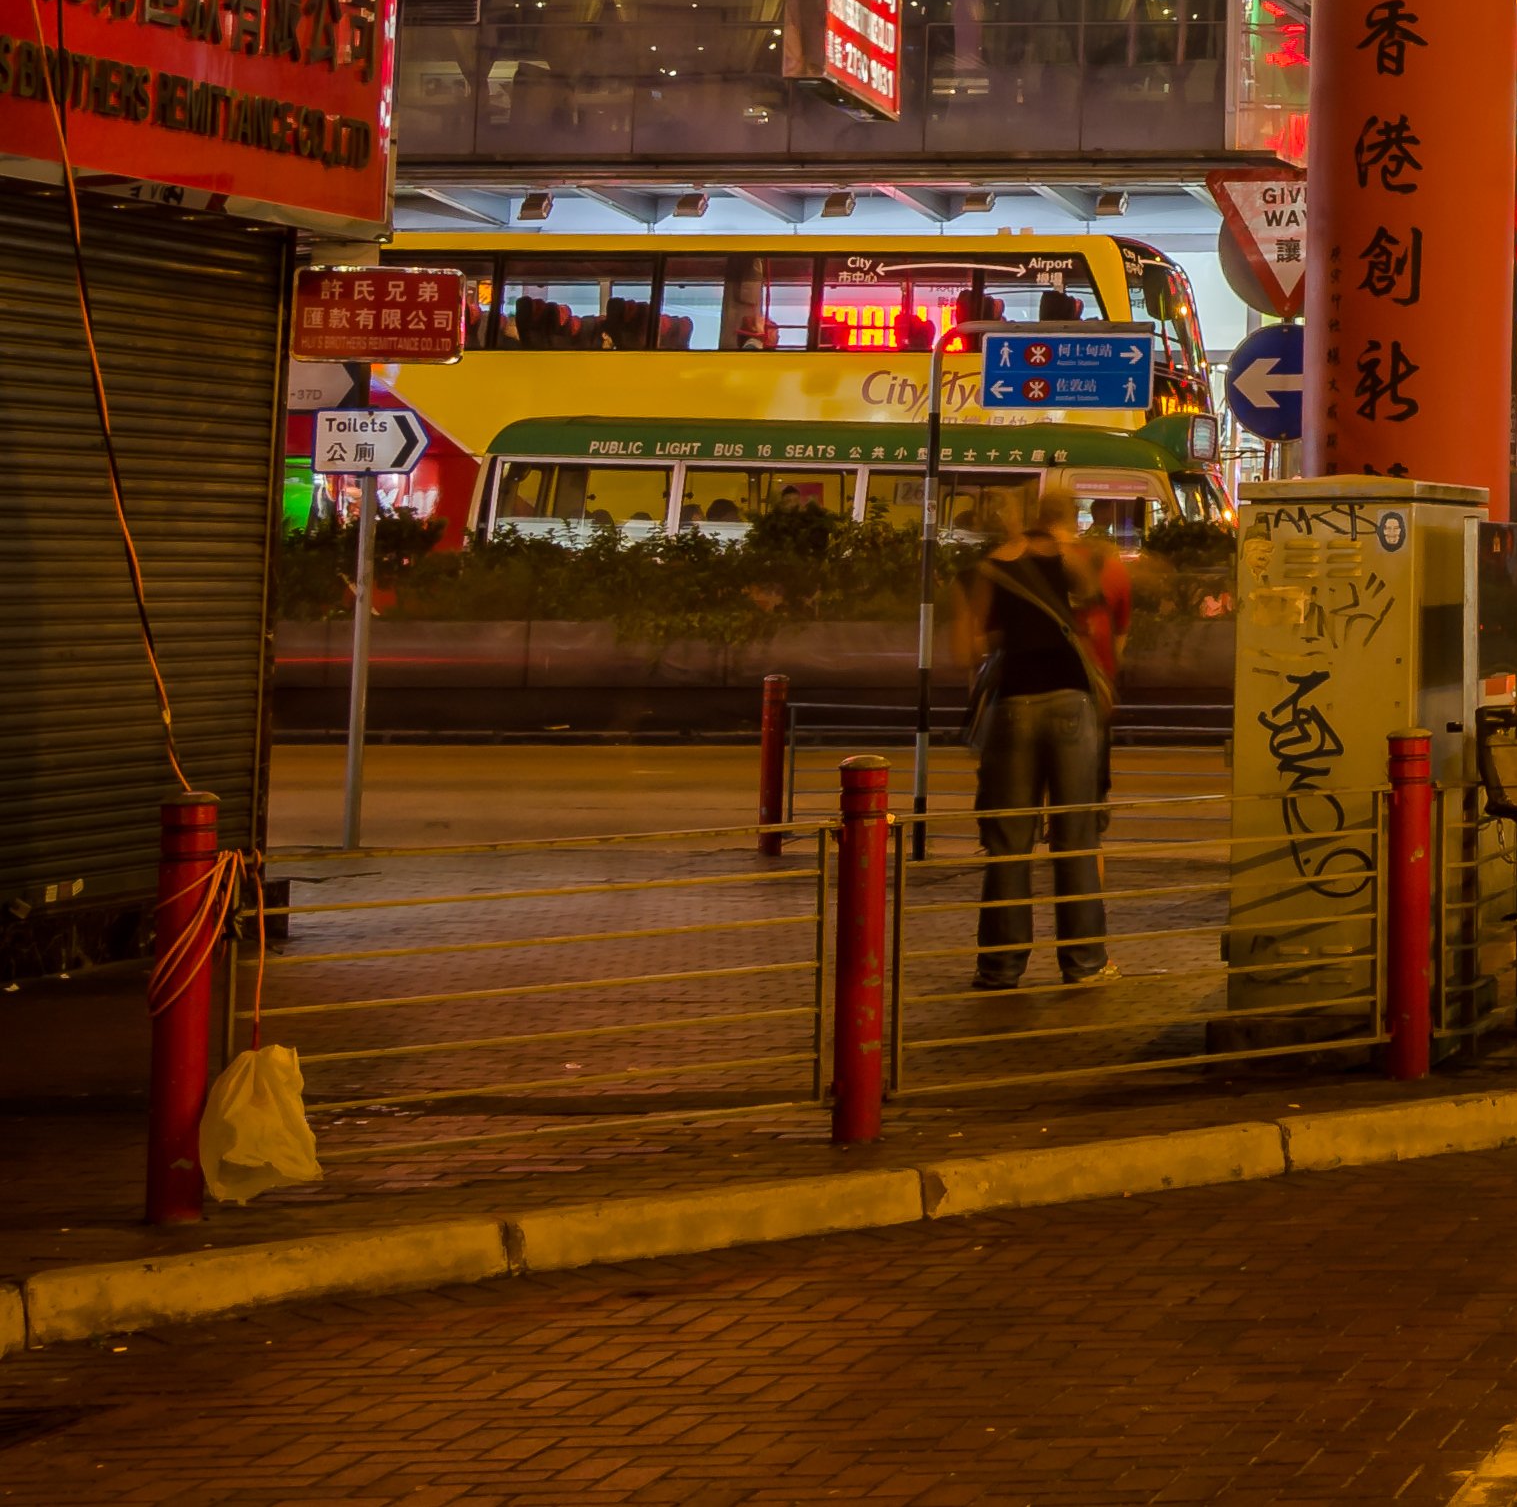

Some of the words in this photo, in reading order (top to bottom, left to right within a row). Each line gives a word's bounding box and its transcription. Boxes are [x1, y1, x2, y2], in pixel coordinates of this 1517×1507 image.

[155, 71, 293, 154] REMITTANCE
[1262, 187, 1308, 205] GIV
[1264, 209, 1308, 227] WA
[1276, 237, 1302, 263] 讓
[847, 256, 872, 269] City
[1028, 257, 1073, 271] Airport
[320, 279, 440, 303] 許氏兄弟
[303, 307, 454, 332] 匯款有限公司
[325, 417, 388, 433] Toilets
[588, 441, 643, 455] PUBLIC
[655, 442, 701, 456] LIGHT
[713, 444, 744, 457] BUS
[756, 444, 772, 458] 16
[784, 445, 837, 459] SEATS
